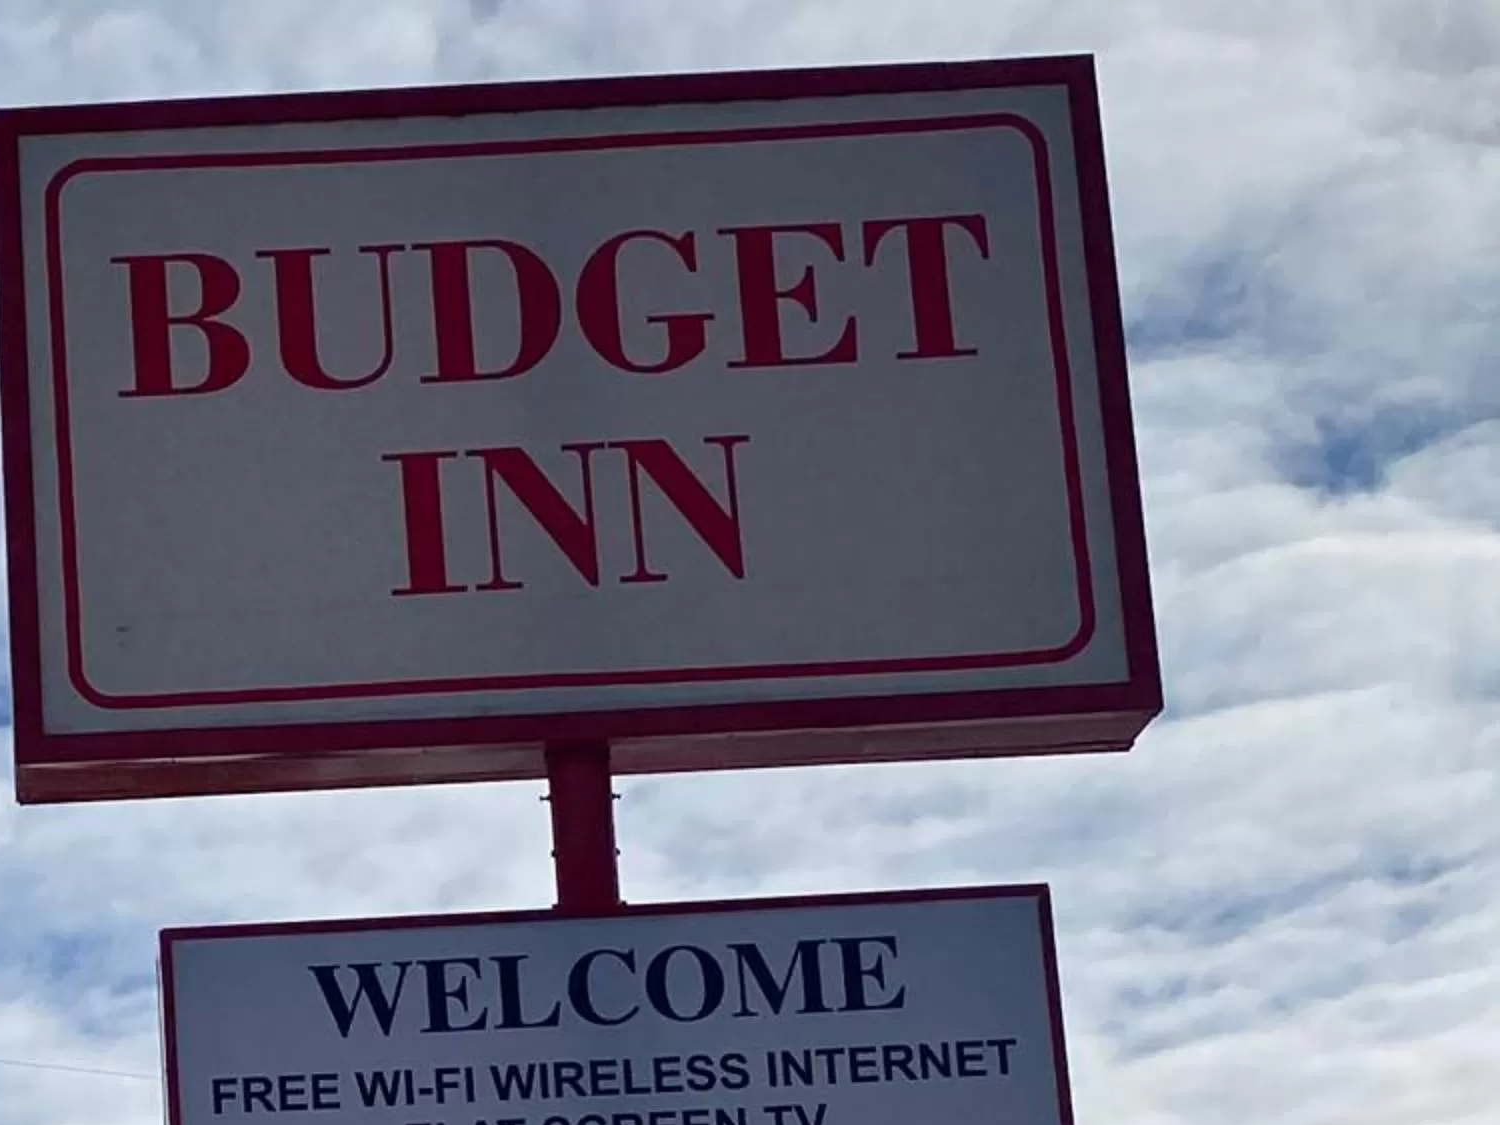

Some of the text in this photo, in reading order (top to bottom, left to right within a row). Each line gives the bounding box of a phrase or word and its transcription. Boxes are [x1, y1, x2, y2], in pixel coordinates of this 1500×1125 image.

[110, 213, 989, 399] BUDGET
[380, 434, 750, 597] INN
[307, 935, 907, 1039] WELCOME
[211, 1038, 1018, 1115] FREE WI-FI WIRELESS INTERNET
